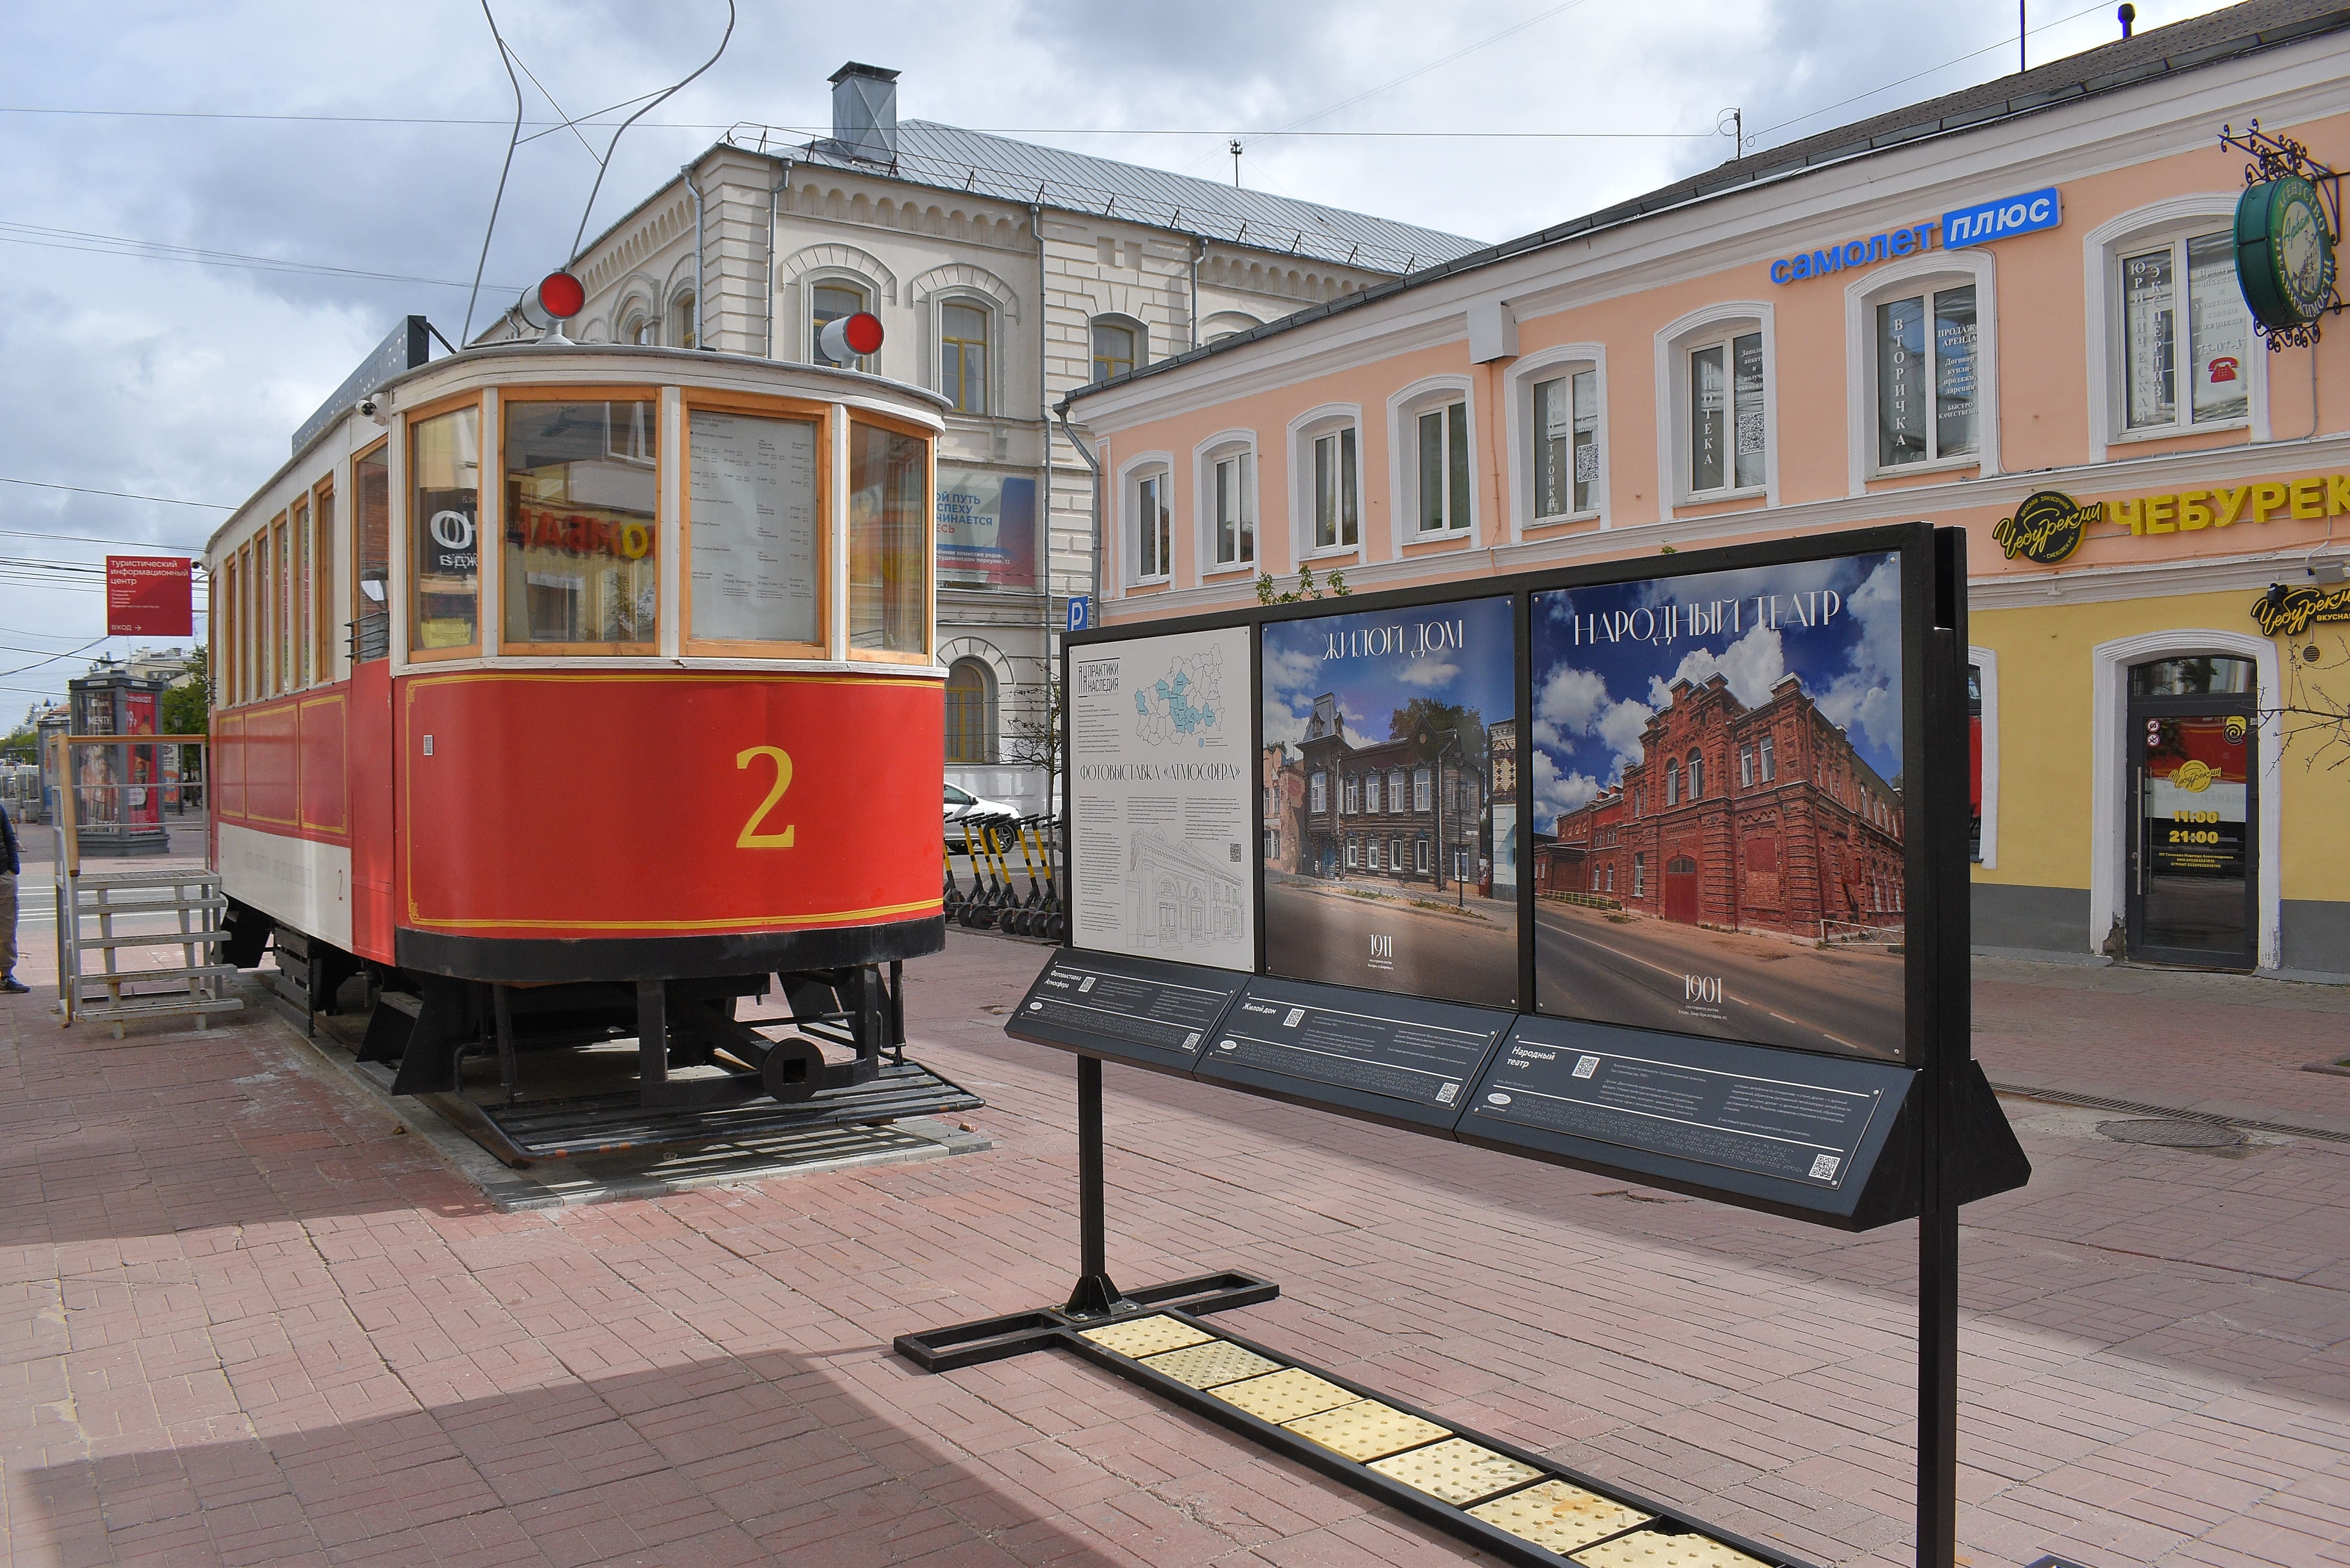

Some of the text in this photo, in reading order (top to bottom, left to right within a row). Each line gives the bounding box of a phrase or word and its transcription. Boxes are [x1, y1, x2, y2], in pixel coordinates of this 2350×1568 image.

[1770, 222, 1939, 285] самолет
[1942, 334, 1977, 347] АРЕНДА
[2130, 262, 2148, 422] ЮРИДИЧЕСКАЯ
[1945, 355, 1975, 367] Договор
[1947, 367, 1973, 375] купли-
[1894, 318, 1906, 446] ВТОРИЧКА
[1944, 385, 1975, 395] дарения
[1948, 402, 1973, 411] БЫСТРО
[1704, 363, 1713, 465] ИПОТЕКА
[1547, 388, 1556, 508] НОВОСТРОЙКИ
[952, 493, 981, 504] ПУТЬ
[2020, 495, 2070, 516] ВКУСНАЯ ЗАКУСОЧНАЯ
[937, 503, 972, 514] СПЕХУ
[110, 568, 189, 577] информационный
[1574, 590, 1840, 646] НАРОДНЫЙ ТЕАТР
[1322, 619, 1462, 660] ЖИЛОЙ ДОМ
[1088, 662, 1119, 678] ПРАКТИКИ
[1088, 677, 1119, 693] НАСЛЕДИЯ
[1080, 763, 1240, 781] ФОТОВЫСТАВКА «АТМОСФЕРА»
[735, 745, 794, 848] 2
[2172, 810, 2219, 824] 11:00
[2169, 830, 2219, 844] 21:00
[1369, 934, 1391, 958] 1911
[1051, 970, 1082, 981] Фотовыставка
[1044, 978, 1069, 989] Атмосфера
[1683, 974, 1722, 1004] 1901
[1241, 1002, 1265, 1012] Жилой
[1511, 1046, 1556, 1060] Народный
[1506, 1058, 1530, 1069] театр
